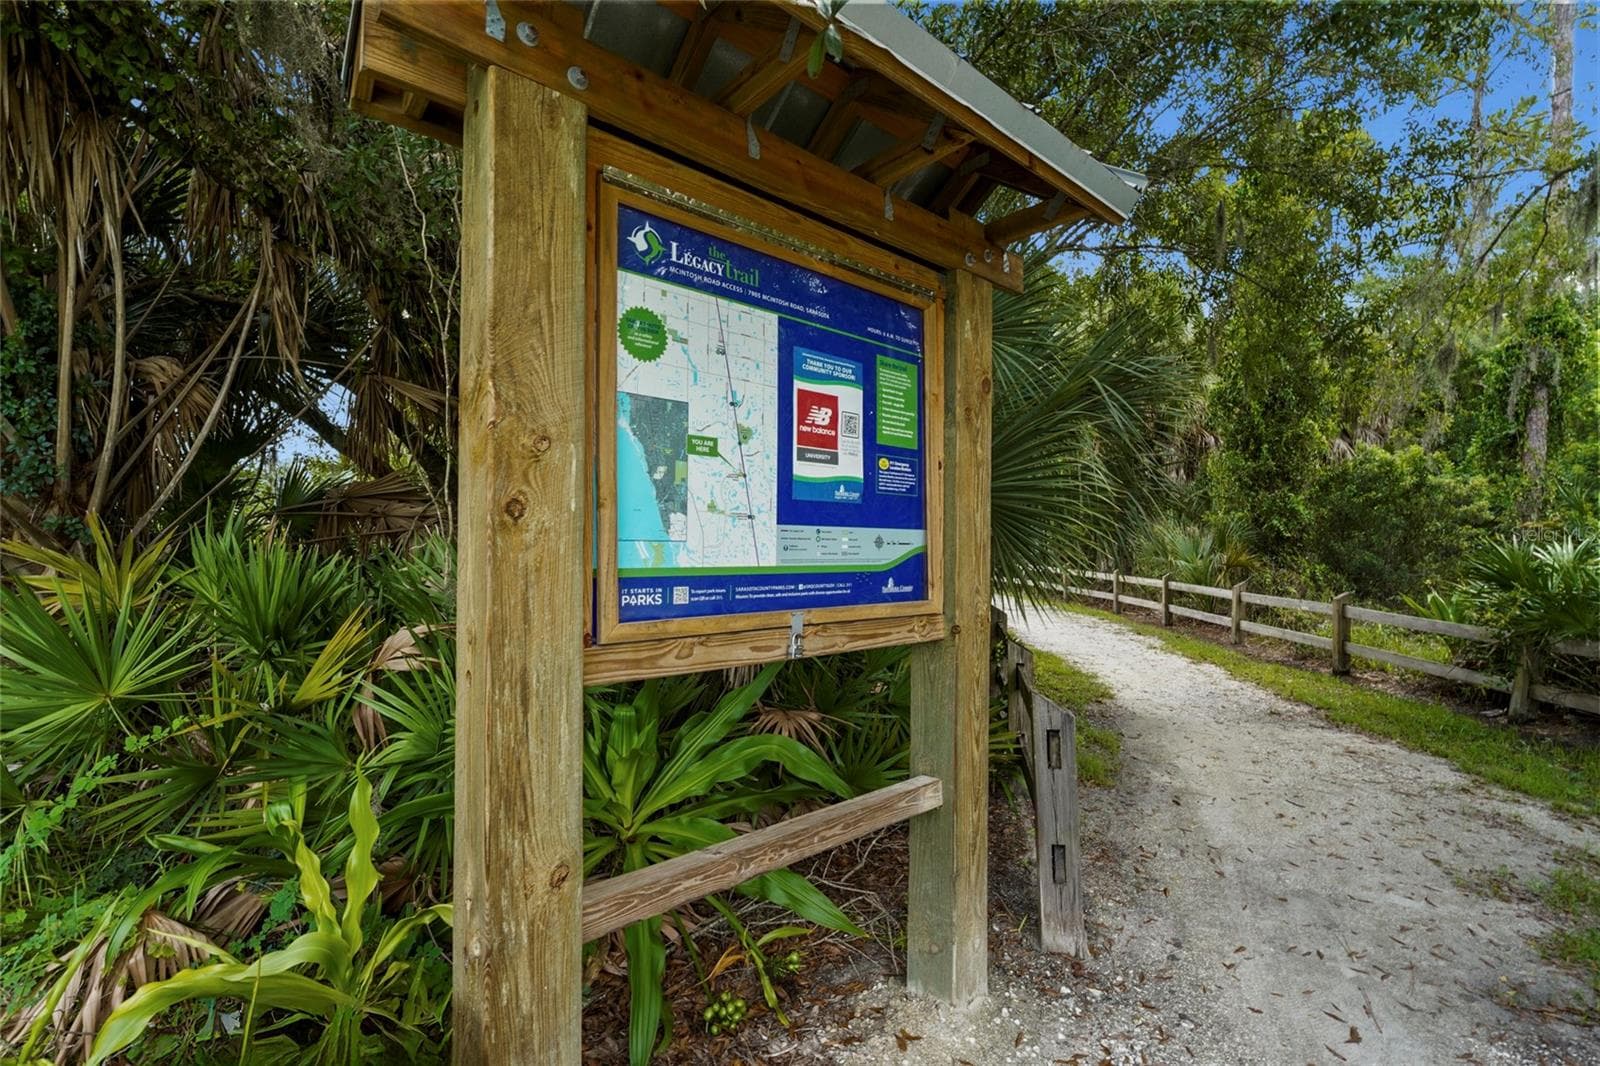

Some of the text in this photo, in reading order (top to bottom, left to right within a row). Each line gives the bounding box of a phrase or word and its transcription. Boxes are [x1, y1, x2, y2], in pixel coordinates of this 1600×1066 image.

[708, 245, 726, 260] the
[726, 260, 759, 288] trail
[669, 266, 703, 281] MCINTOSH
[703, 276, 721, 286] ROAD
[722, 282, 743, 294] ACCESS
[823, 362, 834, 371] YOU
[812, 426, 836, 436] balance
[703, 439, 714, 447] ARE
[695, 445, 710, 453] HERE
[621, 594, 662, 607] PARKS
